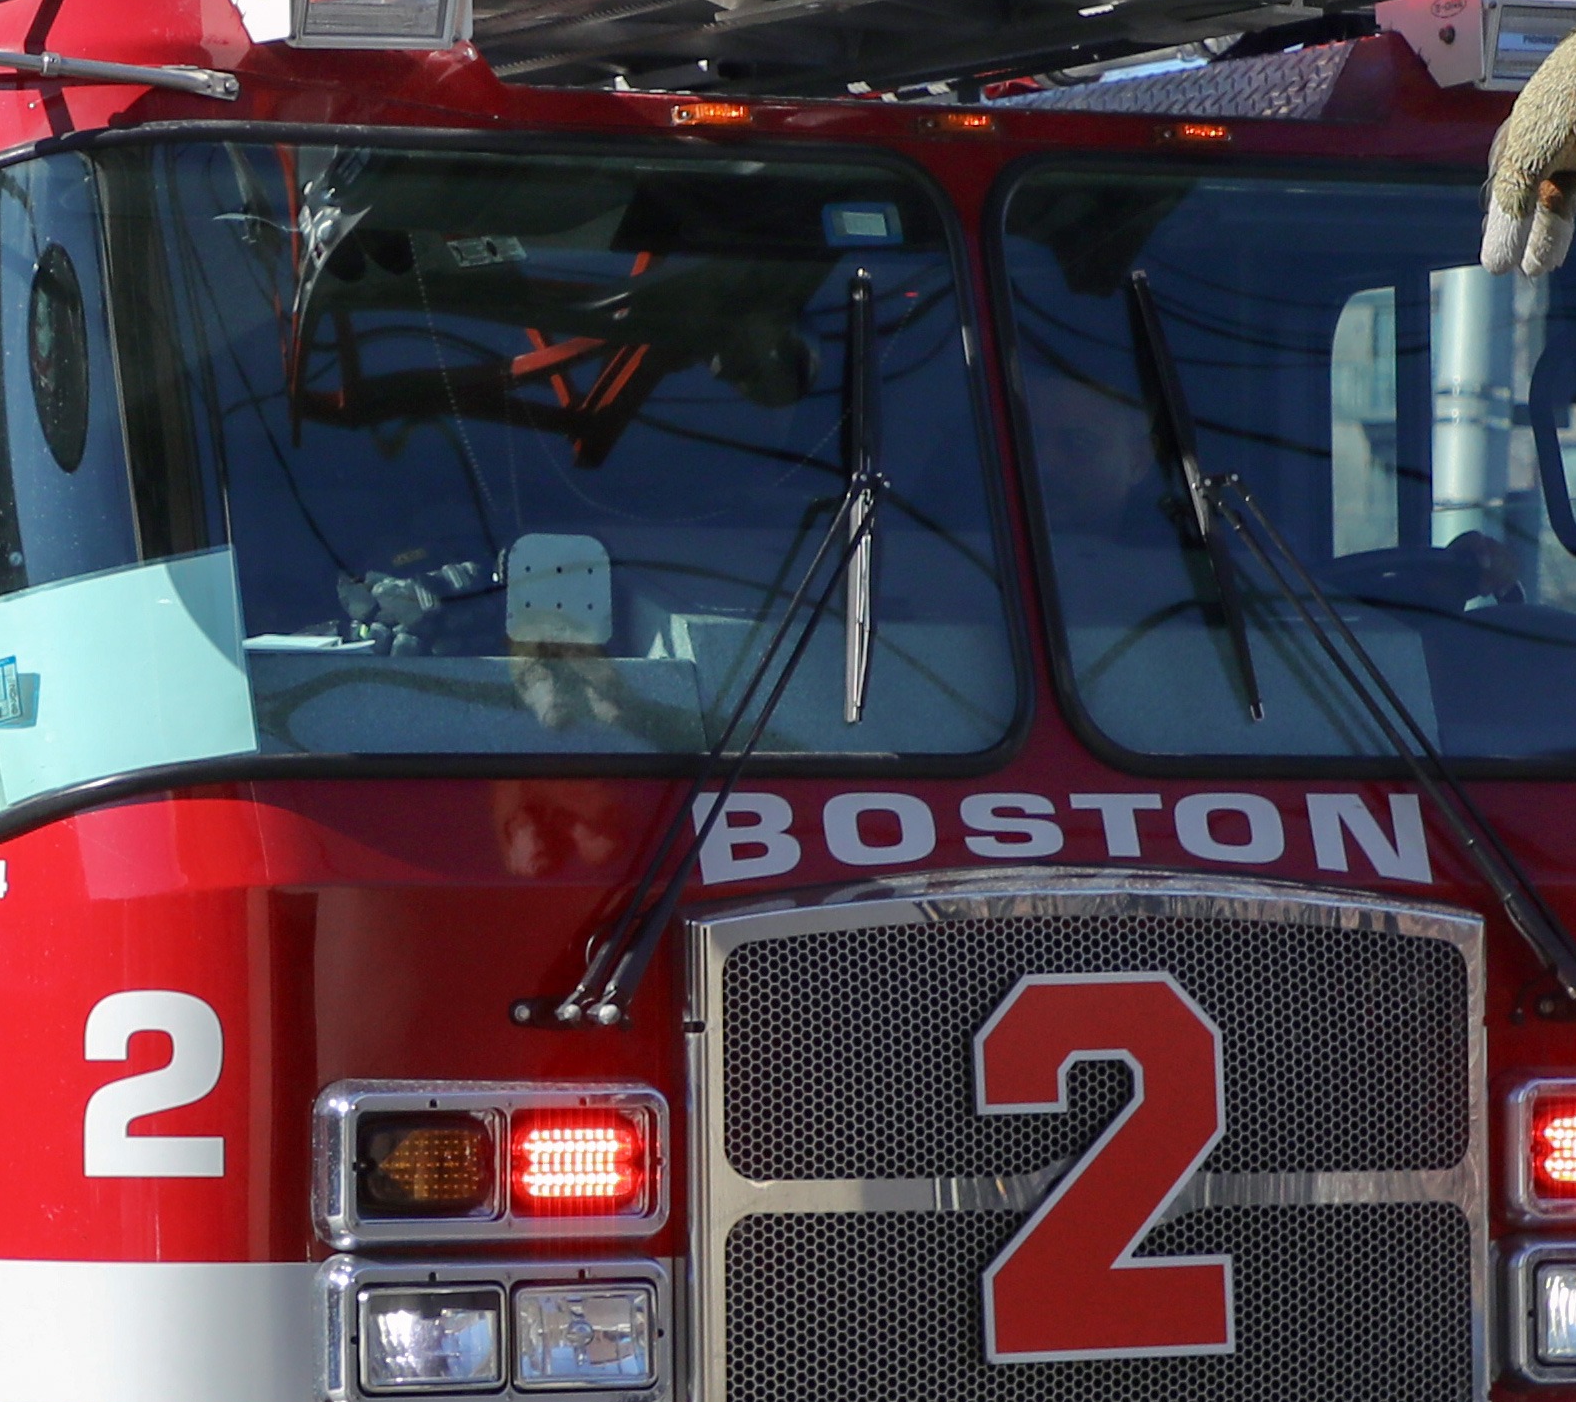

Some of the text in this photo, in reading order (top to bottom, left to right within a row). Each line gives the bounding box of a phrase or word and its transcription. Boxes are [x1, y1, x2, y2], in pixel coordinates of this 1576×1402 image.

[692, 791, 1434, 886] BOSTON
[82, 988, 225, 1179] 2
[973, 970, 1236, 1366] 2
